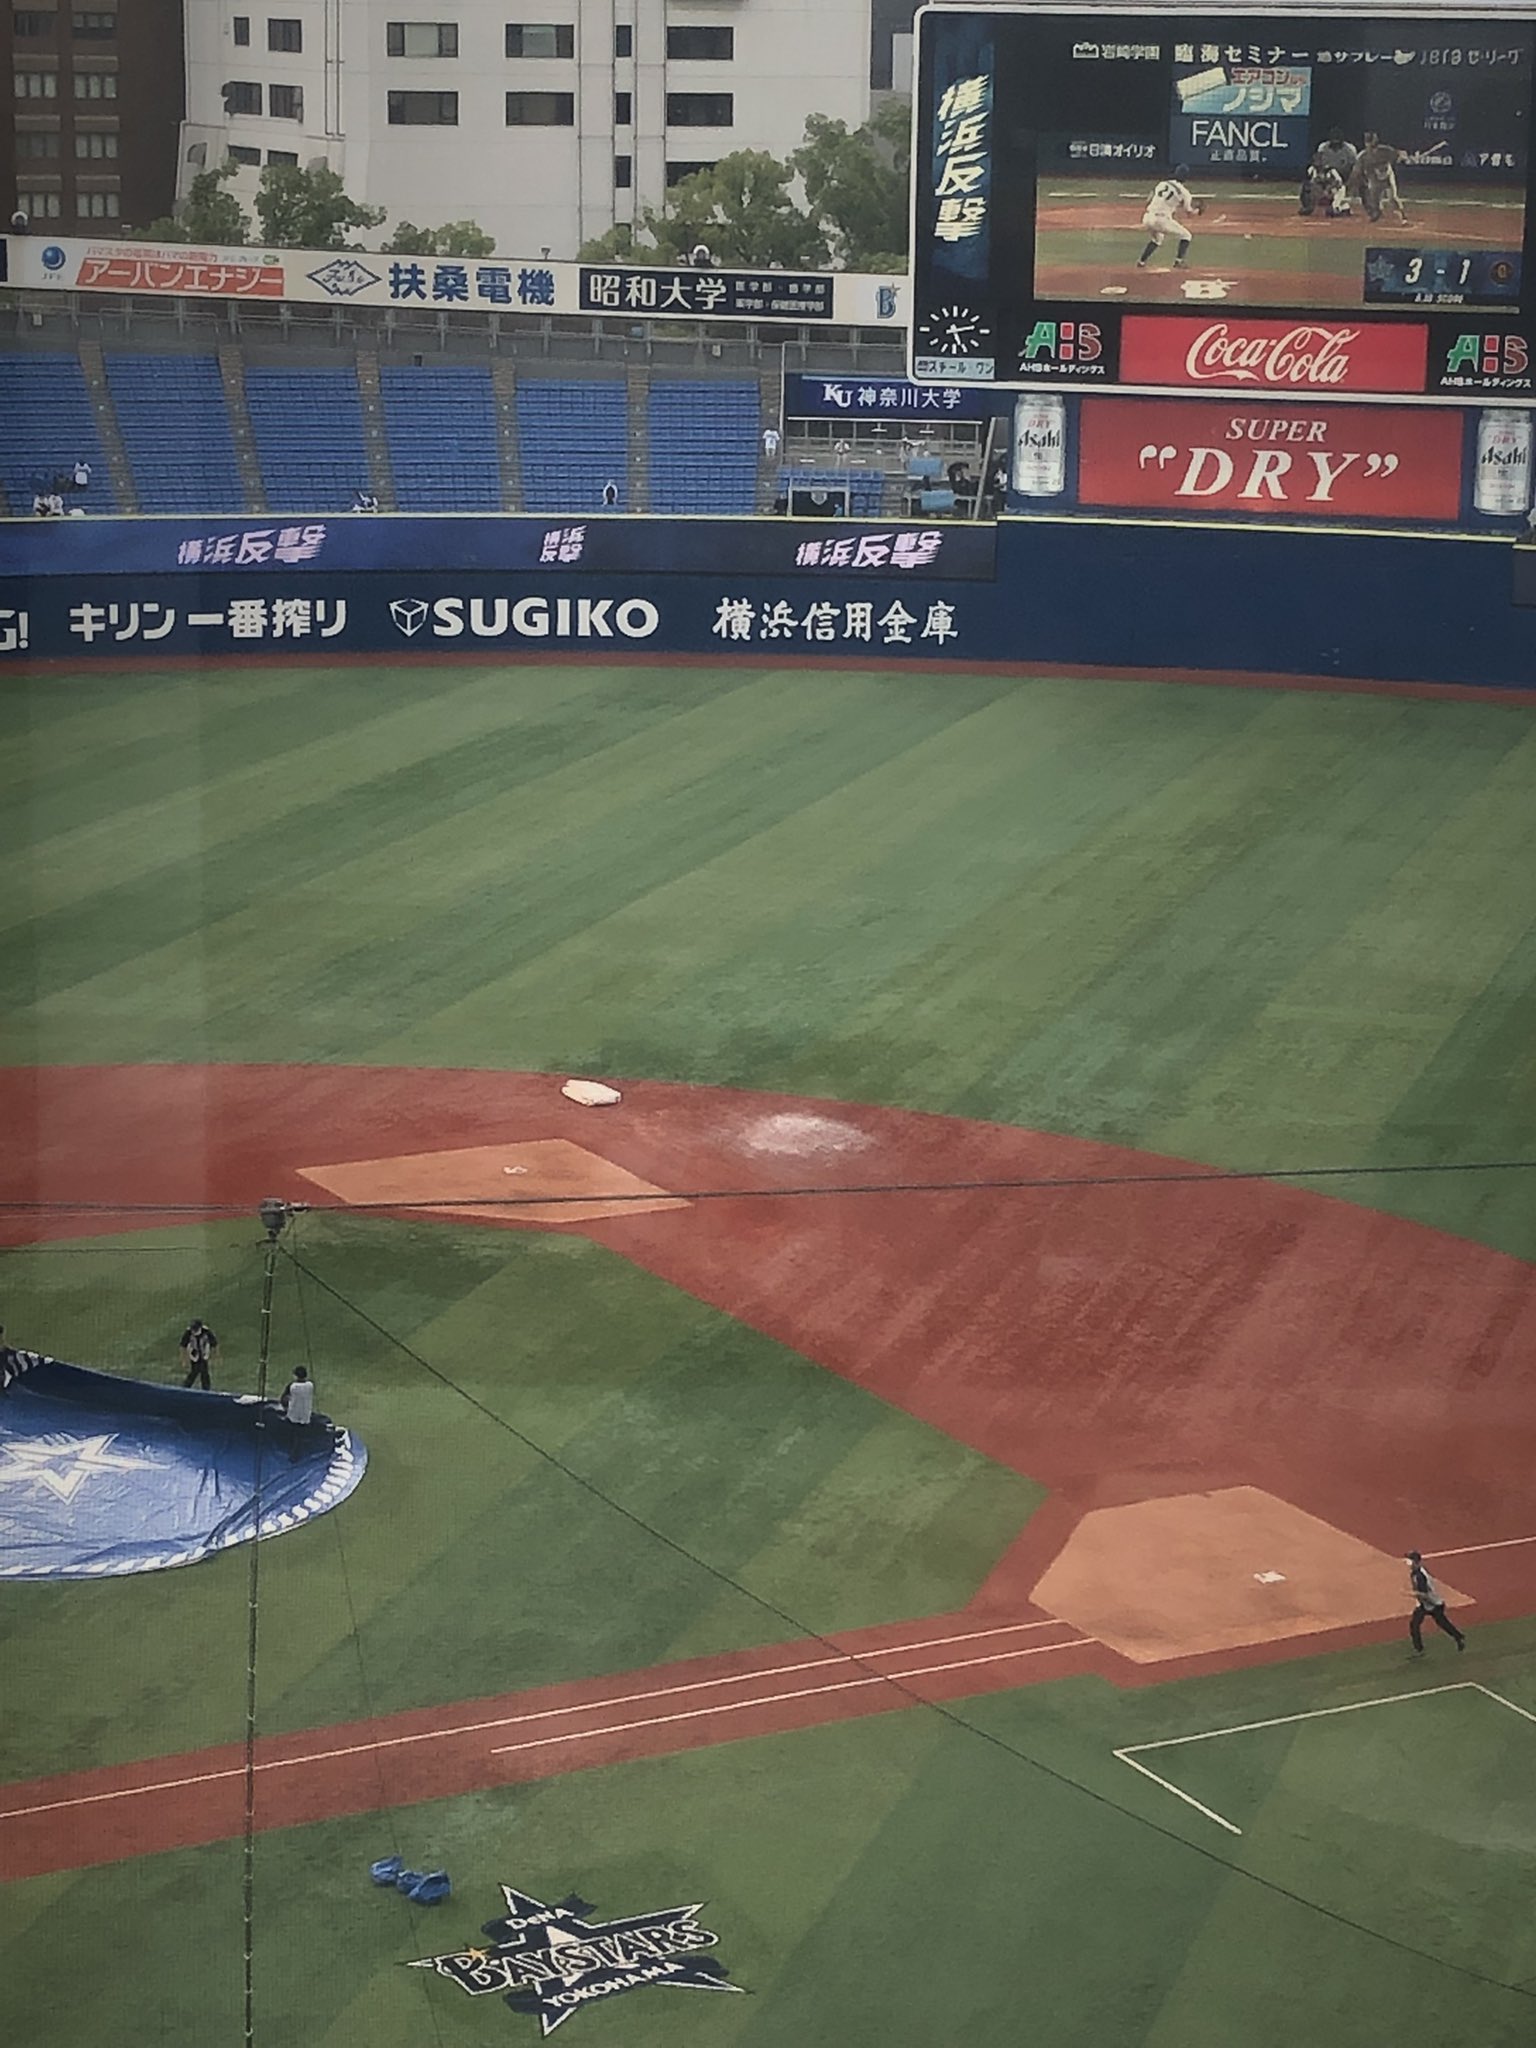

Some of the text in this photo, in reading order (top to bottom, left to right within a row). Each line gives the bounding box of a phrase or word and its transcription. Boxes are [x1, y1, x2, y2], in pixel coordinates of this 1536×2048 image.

[1223, 87, 1302, 114] ノジマ
[1192, 120, 1288, 148] FANCL
[934, 74, 990, 242] 横浜反撃
[85, 258, 283, 294] アーバンエナジー
[389, 262, 556, 306] 扶桑電機
[1404, 257, 1424, 284] 3
[1458, 258, 1471, 285] 1
[589, 273, 727, 310] 昭和大学
[1188, 323, 1361, 384] Coca-Cola
[823, 383, 962, 411] KU 神奈川大学
[1018, 429, 1061, 449] Asahi
[1225, 417, 1327, 443] SUPER
[1480, 445, 1528, 466] Asahi
[177, 524, 327, 565] 横浜反撃
[795, 530, 944, 569] 横浜反撃
[432, 597, 660, 639] SUGIKO
[711, 597, 959, 645] 横浜信用金庫
[435, 1919, 719, 1995] BAYSTARS
[541, 1960, 686, 2008] YOKOHAMA
